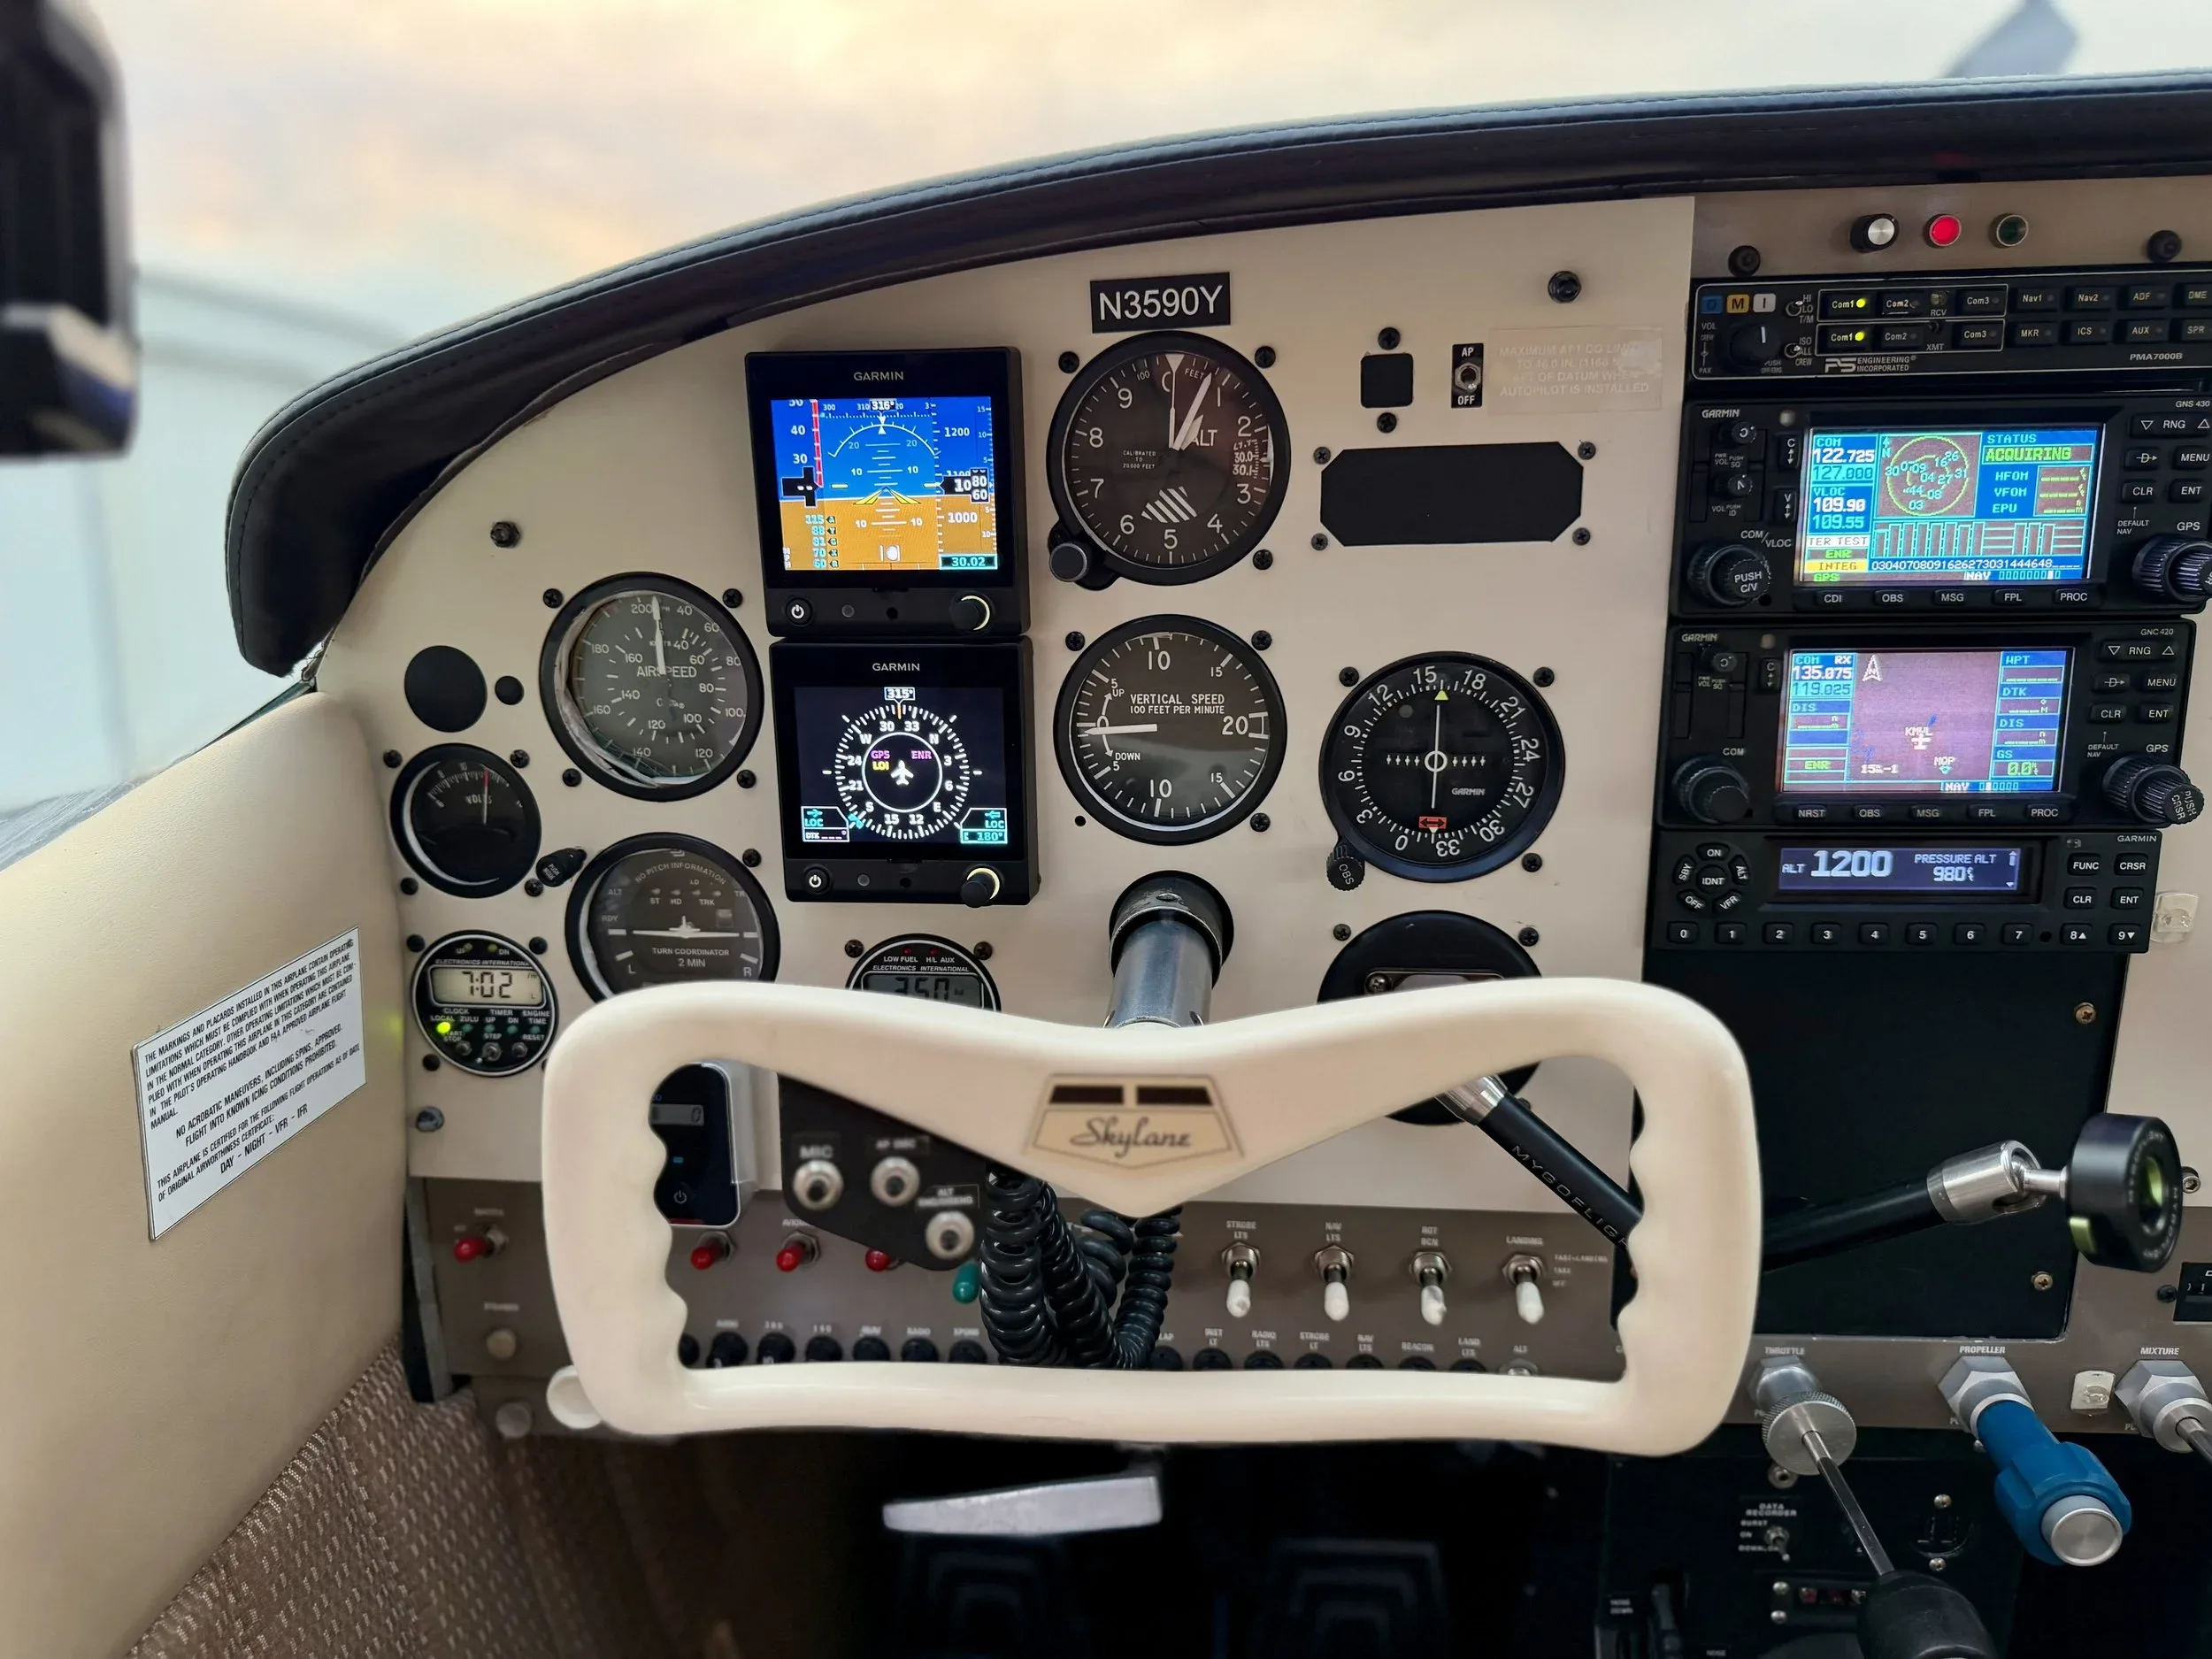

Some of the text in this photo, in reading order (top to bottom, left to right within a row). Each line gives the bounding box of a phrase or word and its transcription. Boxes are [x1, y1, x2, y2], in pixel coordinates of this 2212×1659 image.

[2023, 294, 2042, 303] Nav1
[2078, 294, 2099, 303] Nav2
[2132, 292, 2150, 301] ADF
[2187, 290, 2207, 299] DME
[1099, 284, 1223, 320] N3590Y
[1886, 299, 1909, 308] Com2
[1966, 296, 1989, 305] Com3
[1963, 330, 1987, 339] Com3
[2021, 329, 2039, 338] MKR
[2078, 326, 2092, 336] ICS
[2131, 326, 2150, 334] AUX
[2187, 326, 2205, 334] SPR
[1462, 347, 1474, 357] AP
[2129, 352, 2183, 361] PMA7000B
[1795, 357, 1812, 366] CREW
[1857, 356, 1909, 365] ENGINEERING
[1857, 364, 1909, 373] INCORPORATED
[853, 372, 904, 381] GARMIN
[1185, 368, 1203, 380] FEET
[1458, 396, 1475, 405] OFF
[1701, 409, 1740, 419] GARMIN
[2163, 420, 2185, 429] RNG
[944, 427, 970, 437] 1200
[1816, 438, 1841, 447] COM
[1987, 434, 2036, 443] STATUS
[1814, 448, 1875, 463] 122.725
[1985, 447, 2071, 462] ACQUIRING
[1815, 465, 1873, 480] 127.000
[1995, 472, 2029, 481] HFOM
[1814, 488, 1846, 496] VLOC
[1994, 488, 2027, 497] VFOM
[1814, 497, 1866, 512] 109.90
[1993, 503, 2016, 513] EPU
[948, 512, 978, 523] 1000
[1813, 515, 1864, 529] 109.55
[2177, 522, 2200, 531] GPS
[951, 557, 986, 566] 30.02
[1734, 572, 1763, 583] PUSH
[1740, 583, 1757, 593] C/V
[2004, 593, 2022, 602] FPL
[2060, 592, 2087, 601] PROC
[1834, 656, 1852, 664] RX
[872, 663, 920, 672] GARMIN
[1413, 665, 1437, 685] 15
[1793, 665, 1852, 680] 135.075
[1793, 682, 1851, 695] 119.025
[2002, 687, 2027, 696] DTK
[1130, 695, 1225, 704] VERTICAL SPEED
[1222, 717, 1248, 734] 20
[871, 750, 933, 759] GPS ENR
[1804, 761, 1831, 770] ENR
[805, 818, 823, 827] LOC
[1811, 850, 1893, 877] 1200
[1915, 854, 1996, 864] PRESSURE ALT
[1678, 863, 1692, 880] SBY
[1736, 865, 1748, 881] ALT
[1782, 864, 1806, 873] ALT
[1339, 864, 1355, 885] OBS
[1686, 895, 1705, 910] OFF
[1720, 895, 1739, 910] VFR
[2120, 895, 2139, 904] ENT
[462, 972, 512, 998] 7:02
[176, 1127, 186, 1139] NO
[188, 1101, 222, 1132] ACROBATIC
[265, 1054, 295, 1079] INCLUDING
[185, 1061, 303, 1147] FLIGHT INTO KNOWN ICING CONDITIONS
[220, 1104, 308, 1173] DAY NIGHT VFR IFR
[1070, 1116, 1192, 1158] Skylane
[1960, 1345, 2006, 1355] PROPELLER
